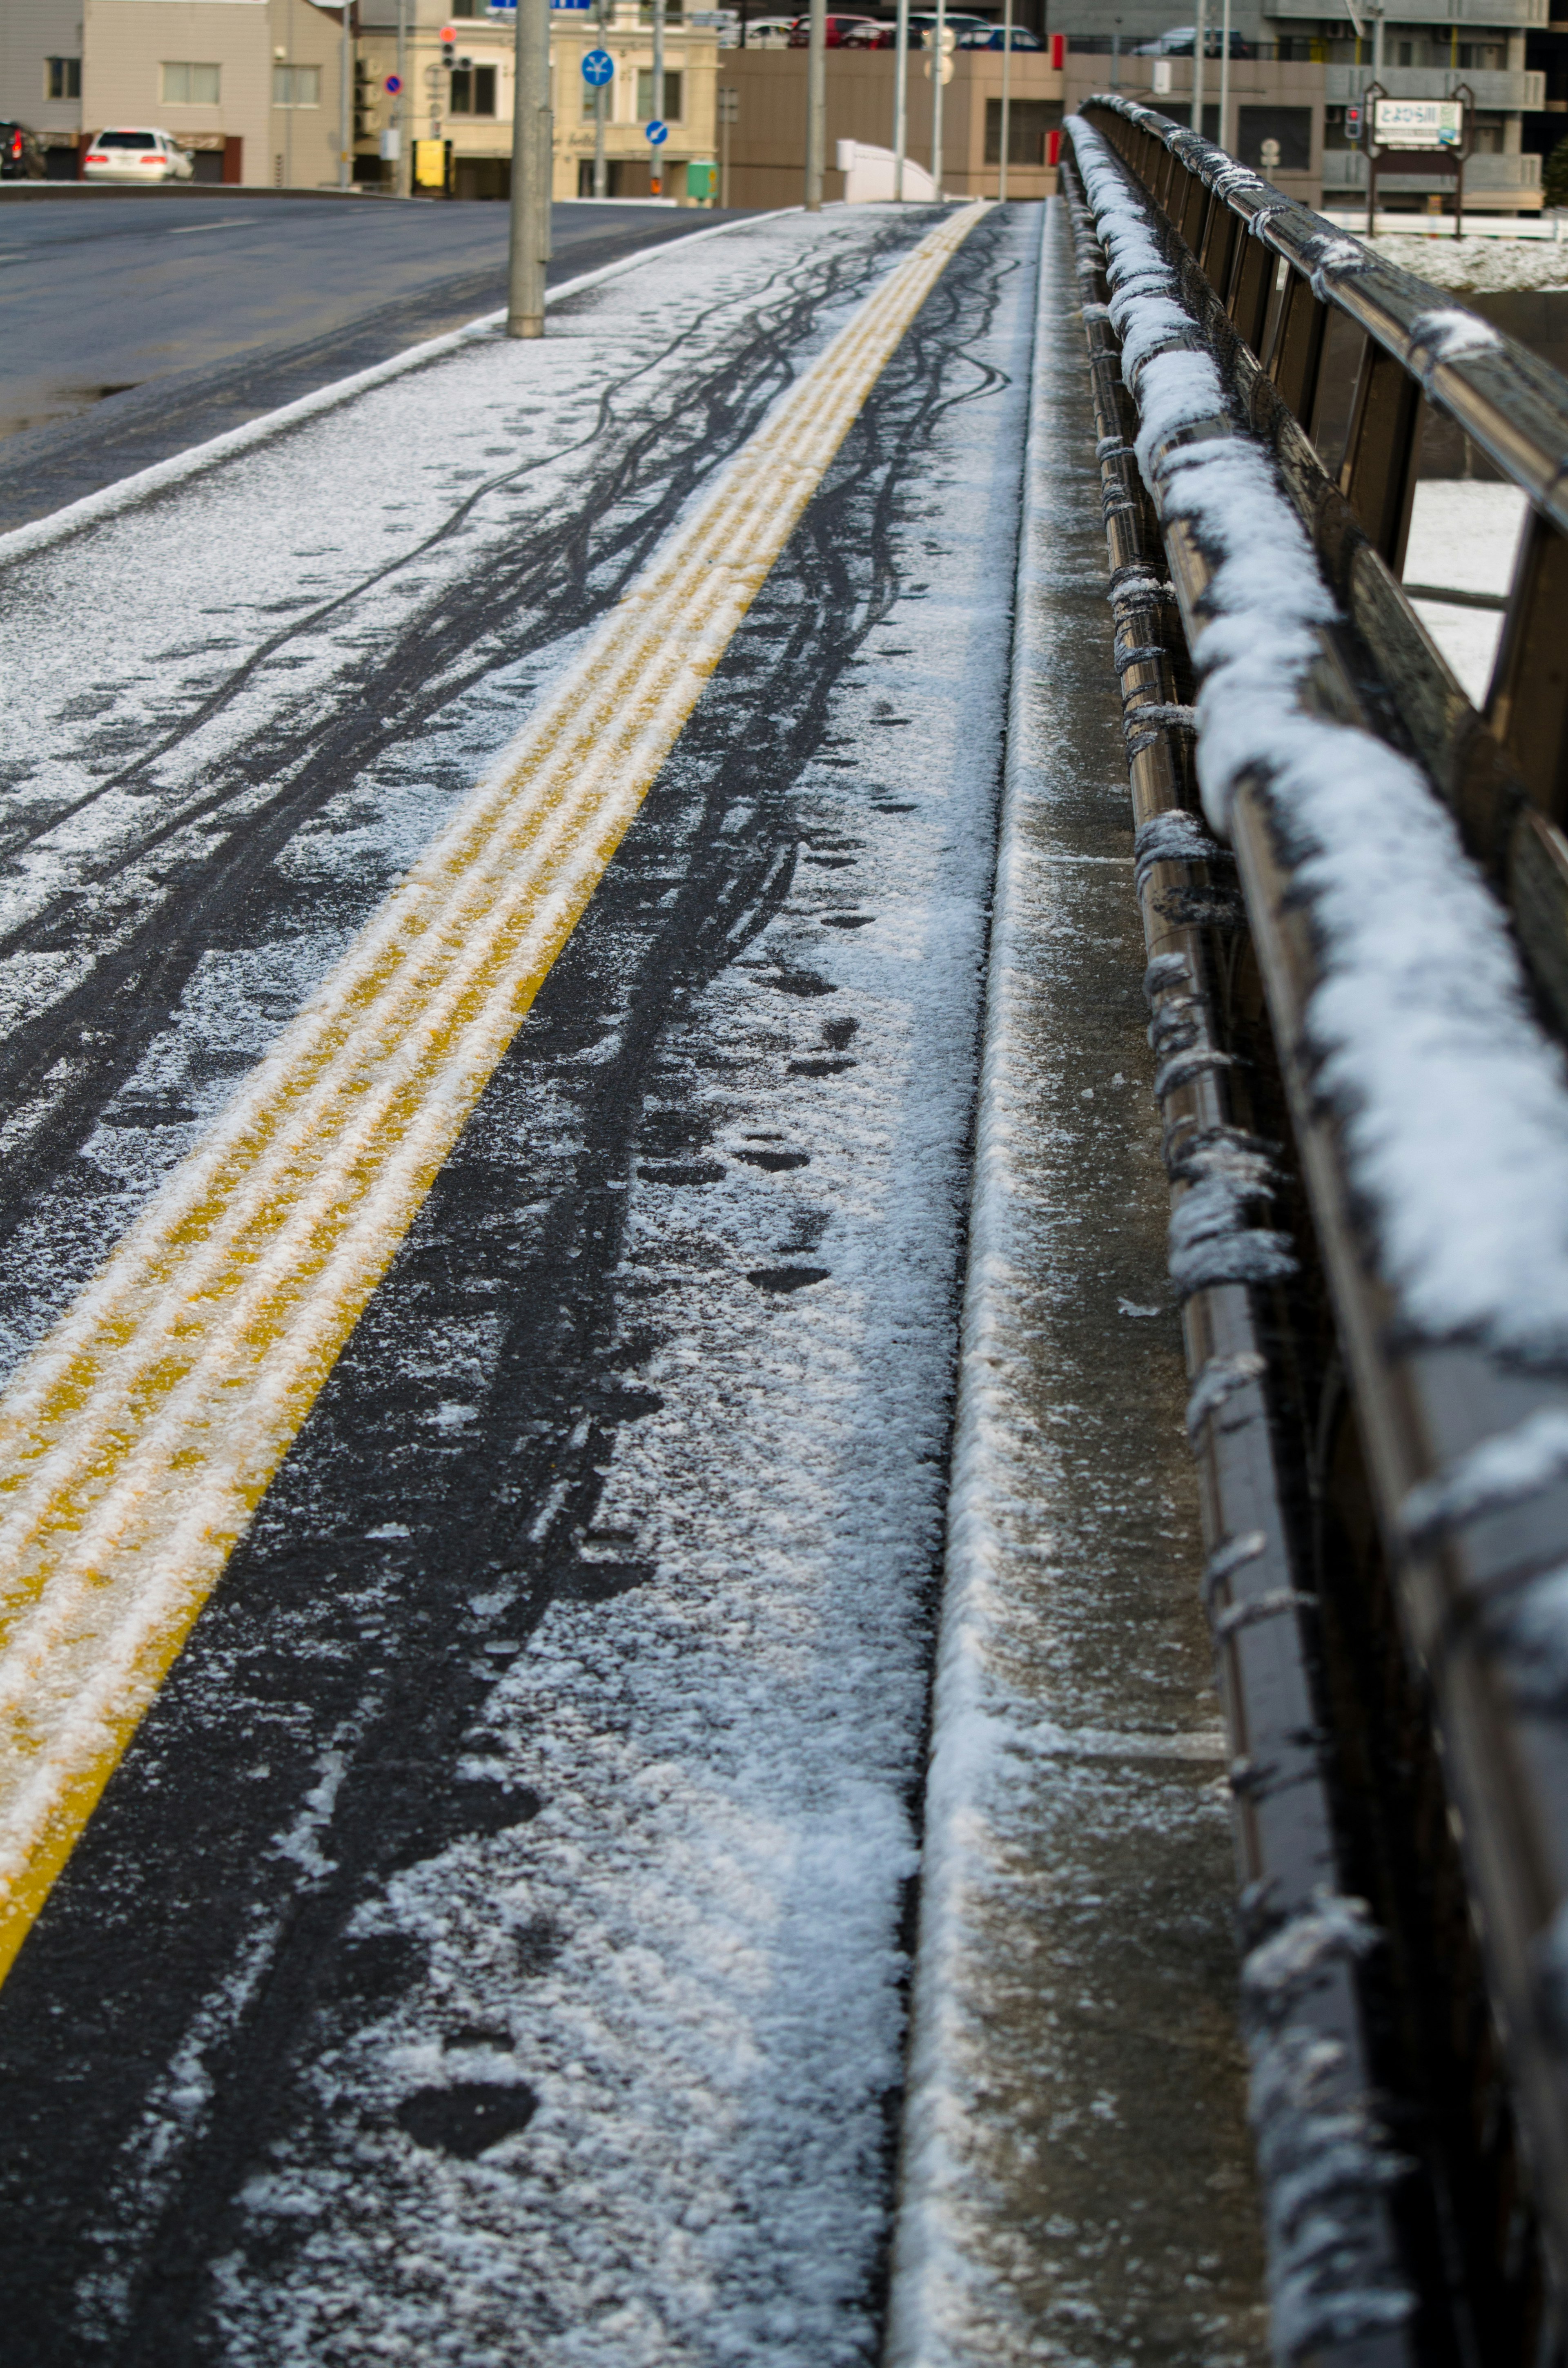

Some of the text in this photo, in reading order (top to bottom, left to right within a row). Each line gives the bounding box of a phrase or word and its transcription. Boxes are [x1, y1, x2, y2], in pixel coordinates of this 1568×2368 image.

[1381, 106, 1437, 123] とよひら川
